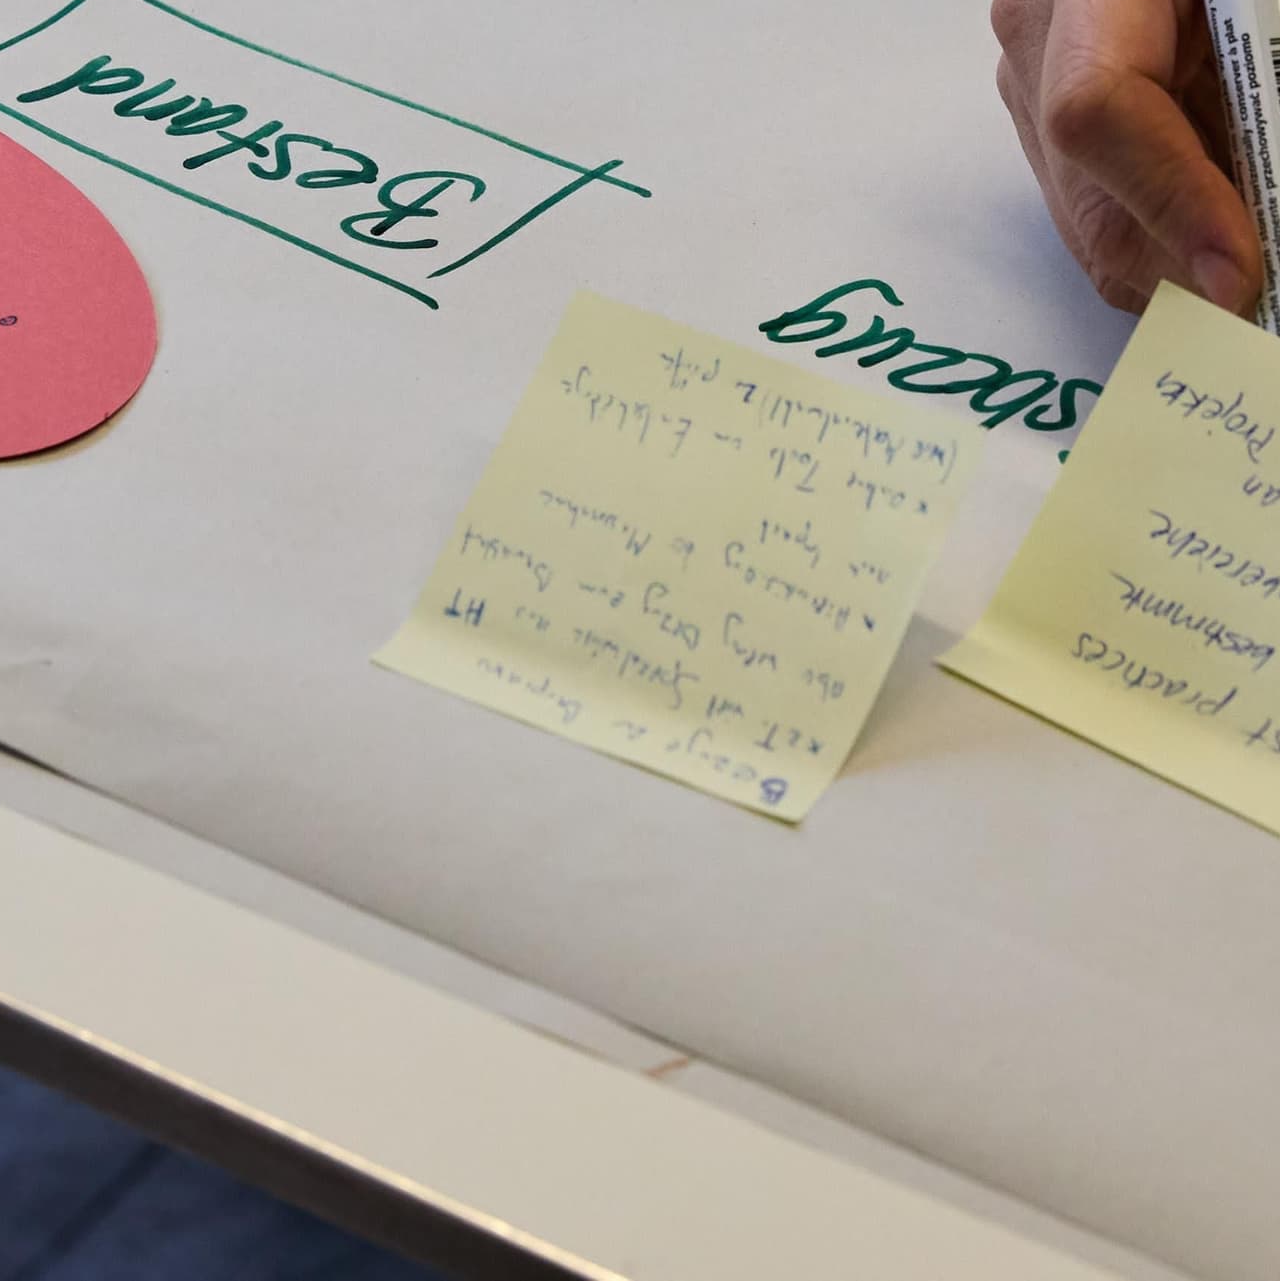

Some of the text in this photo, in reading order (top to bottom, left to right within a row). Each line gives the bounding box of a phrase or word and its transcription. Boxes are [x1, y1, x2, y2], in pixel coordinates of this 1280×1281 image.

[1224, 17, 1239, 46] plat
[1241, 33, 1258, 90] poziomo
[1231, 59, 1247, 122] conserver
[15, 54, 488, 251] Bestand
[1249, 89, 1278, 189] przechowywać
[757, 277, 1105, 465] sbezug
[1111, 572, 1277, 671] bestimmte
[1071, 631, 1238, 717] practices
